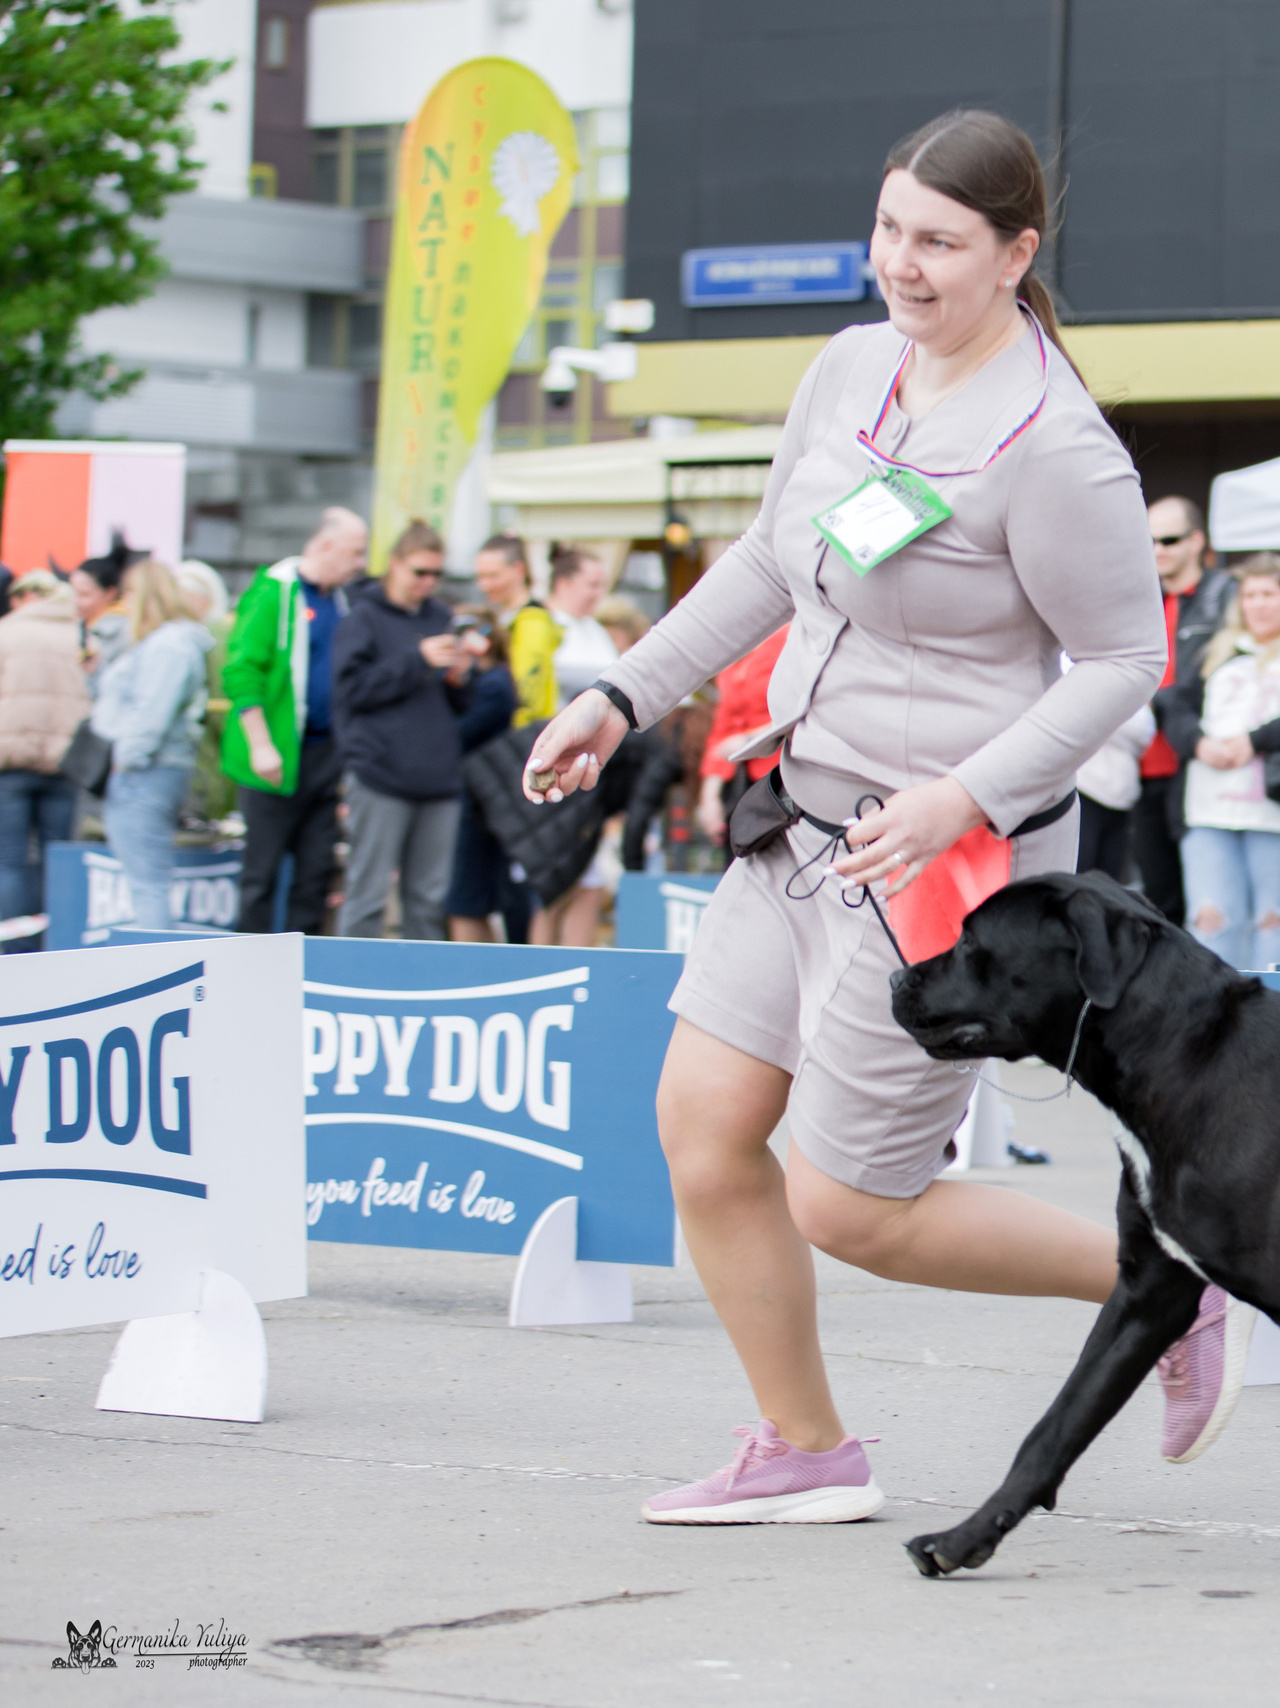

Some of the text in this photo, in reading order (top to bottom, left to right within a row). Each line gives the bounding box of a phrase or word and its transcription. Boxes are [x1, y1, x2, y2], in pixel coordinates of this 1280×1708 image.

[190, 876, 239, 927] DO
[43, 1007, 192, 1156] DOG
[428, 1004, 575, 1132] DOG
[306, 1157, 517, 1226] you feed is love
[48, 1244, 76, 1279] is
[86, 1221, 143, 1279] love
